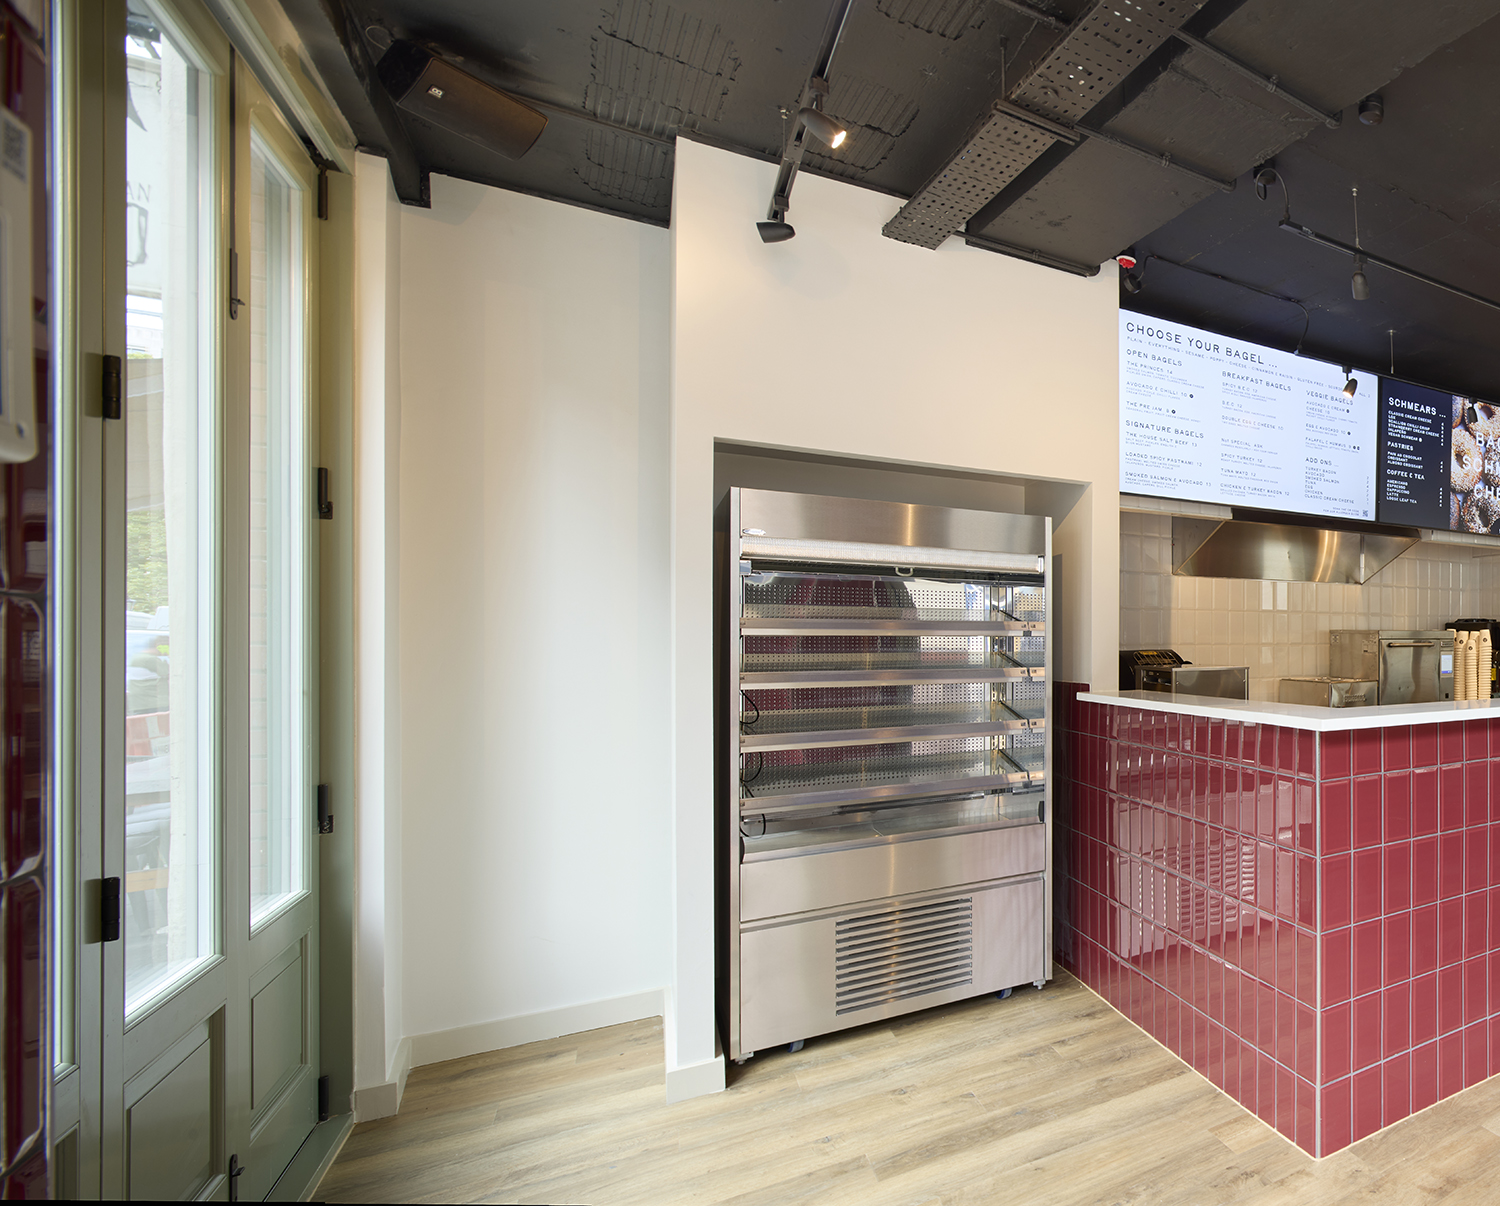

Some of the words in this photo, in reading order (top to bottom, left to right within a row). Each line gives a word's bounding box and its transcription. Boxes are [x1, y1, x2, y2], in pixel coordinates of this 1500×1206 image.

[1127, 322, 1182, 345] CHOOSE
[1188, 337, 1220, 354] YOUR
[1226, 347, 1264, 365] BAGEL
[1127, 349, 1148, 359] OPEN
[1152, 354, 1182, 367] BAGELS
[1222, 371, 1263, 385] BREAKFAST
[1266, 380, 1291, 392] BAGELS
[1306, 390, 1329, 400] VEGGIE
[1331, 396, 1353, 406] BAGELS
[1389, 397, 1437, 416] SCHMEARS
[1126, 420, 1171, 434] SIGNATURE
[1175, 428, 1204, 439] BAGELS
[1388, 441, 1414, 451] PASTRIES
[1387, 469, 1408, 477] COFFEE
